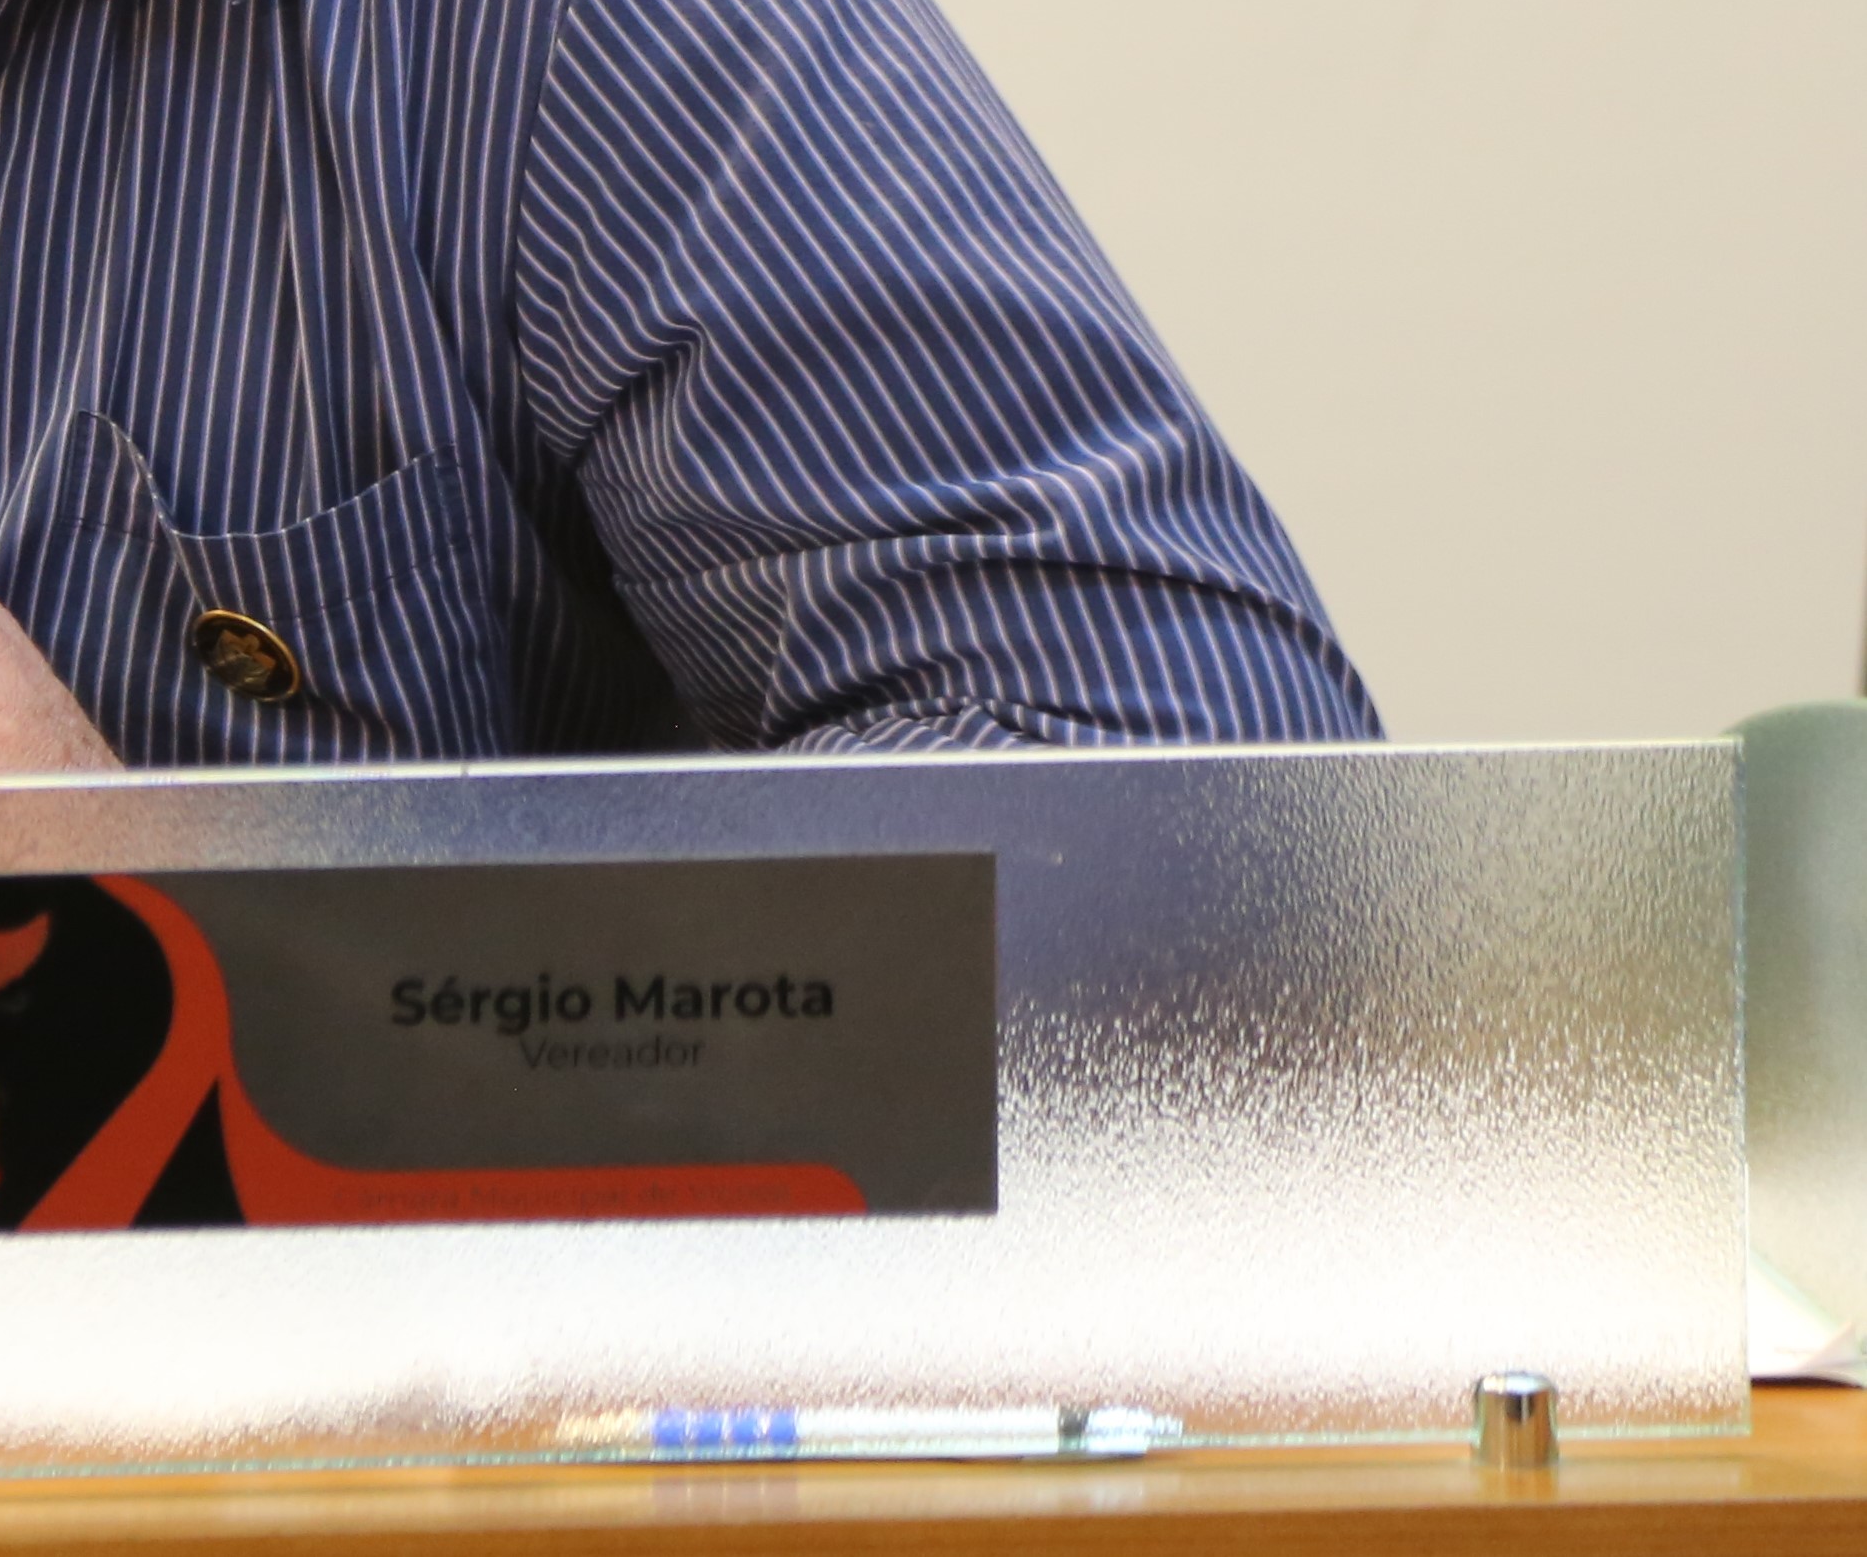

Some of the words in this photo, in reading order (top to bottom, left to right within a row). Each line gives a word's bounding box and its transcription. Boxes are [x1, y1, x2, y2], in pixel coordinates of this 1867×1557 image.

[390, 973, 592, 1036] Sérgio
[614, 973, 835, 1023] Marota
[519, 1036, 707, 1071] Vereador
